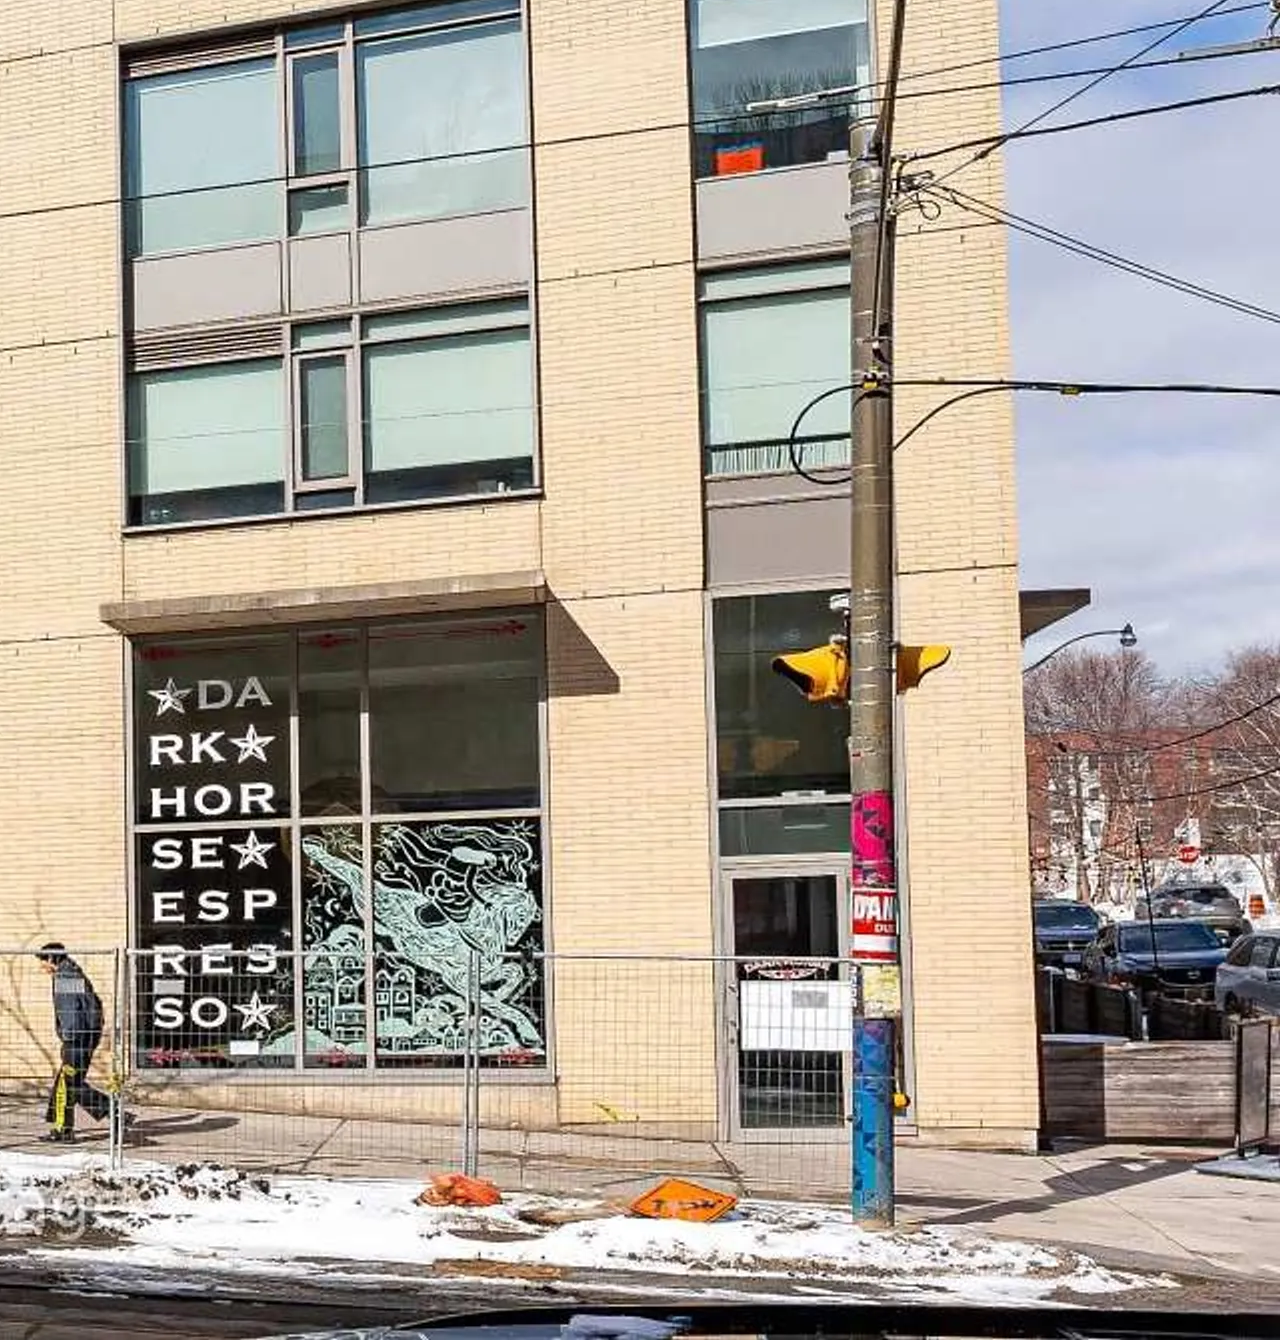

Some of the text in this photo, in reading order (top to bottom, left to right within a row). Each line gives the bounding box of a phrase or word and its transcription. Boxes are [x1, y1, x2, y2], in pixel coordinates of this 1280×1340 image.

[198, 676, 273, 710] DA
[149, 731, 226, 766] RK
[150, 782, 277, 818] HOR
[151, 836, 224, 870] SE
[153, 889, 278, 923] ESP
[153, 944, 278, 976] RES
[153, 997, 229, 1029] SO
